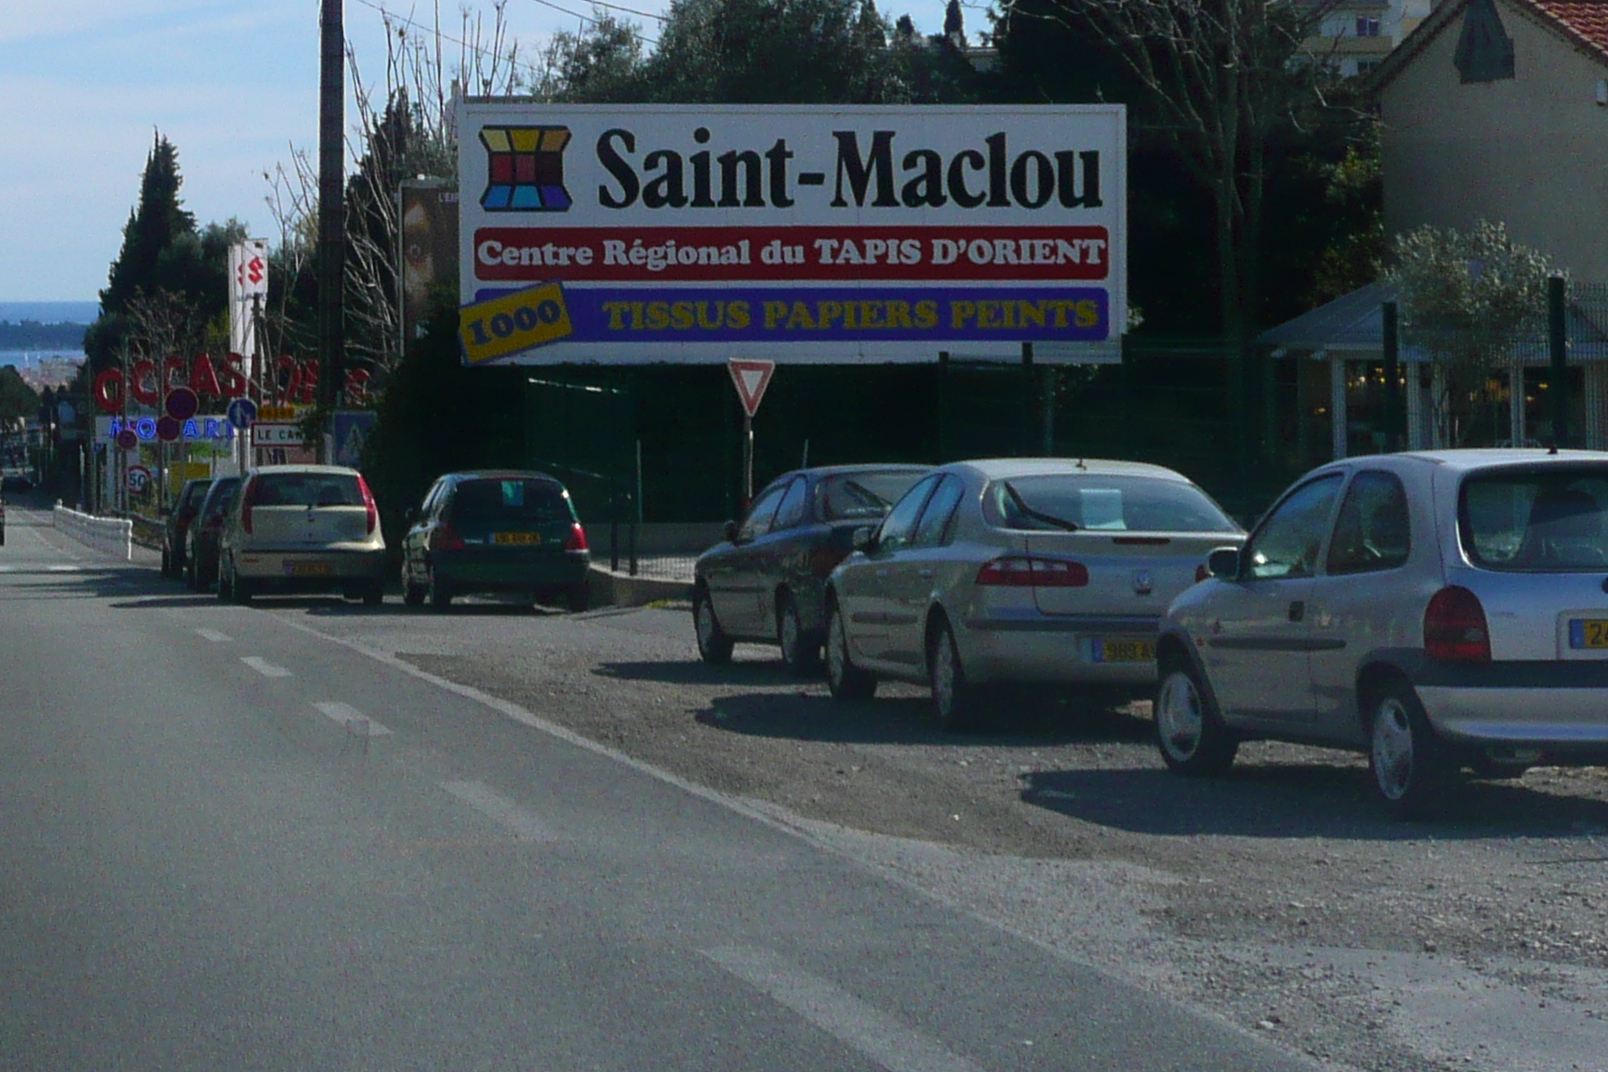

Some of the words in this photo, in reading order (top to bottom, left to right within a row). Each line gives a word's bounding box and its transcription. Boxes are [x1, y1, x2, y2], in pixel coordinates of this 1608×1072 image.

[596, 126, 1104, 210] Saint-Maclou
[477, 239, 593, 266] Centre
[602, 238, 751, 271] Régional
[760, 239, 806, 265] du
[813, 238, 922, 265] TAPIS
[931, 238, 1106, 265] D'ORIENT
[467, 298, 562, 346] 1000
[601, 300, 751, 330] TISSUS
[762, 300, 939, 329] PAPIERS
[950, 299, 1100, 329] PEINTS
[108, 417, 235, 440] MOART
[257, 429, 271, 440] LE
[129, 473, 147, 486] 50
